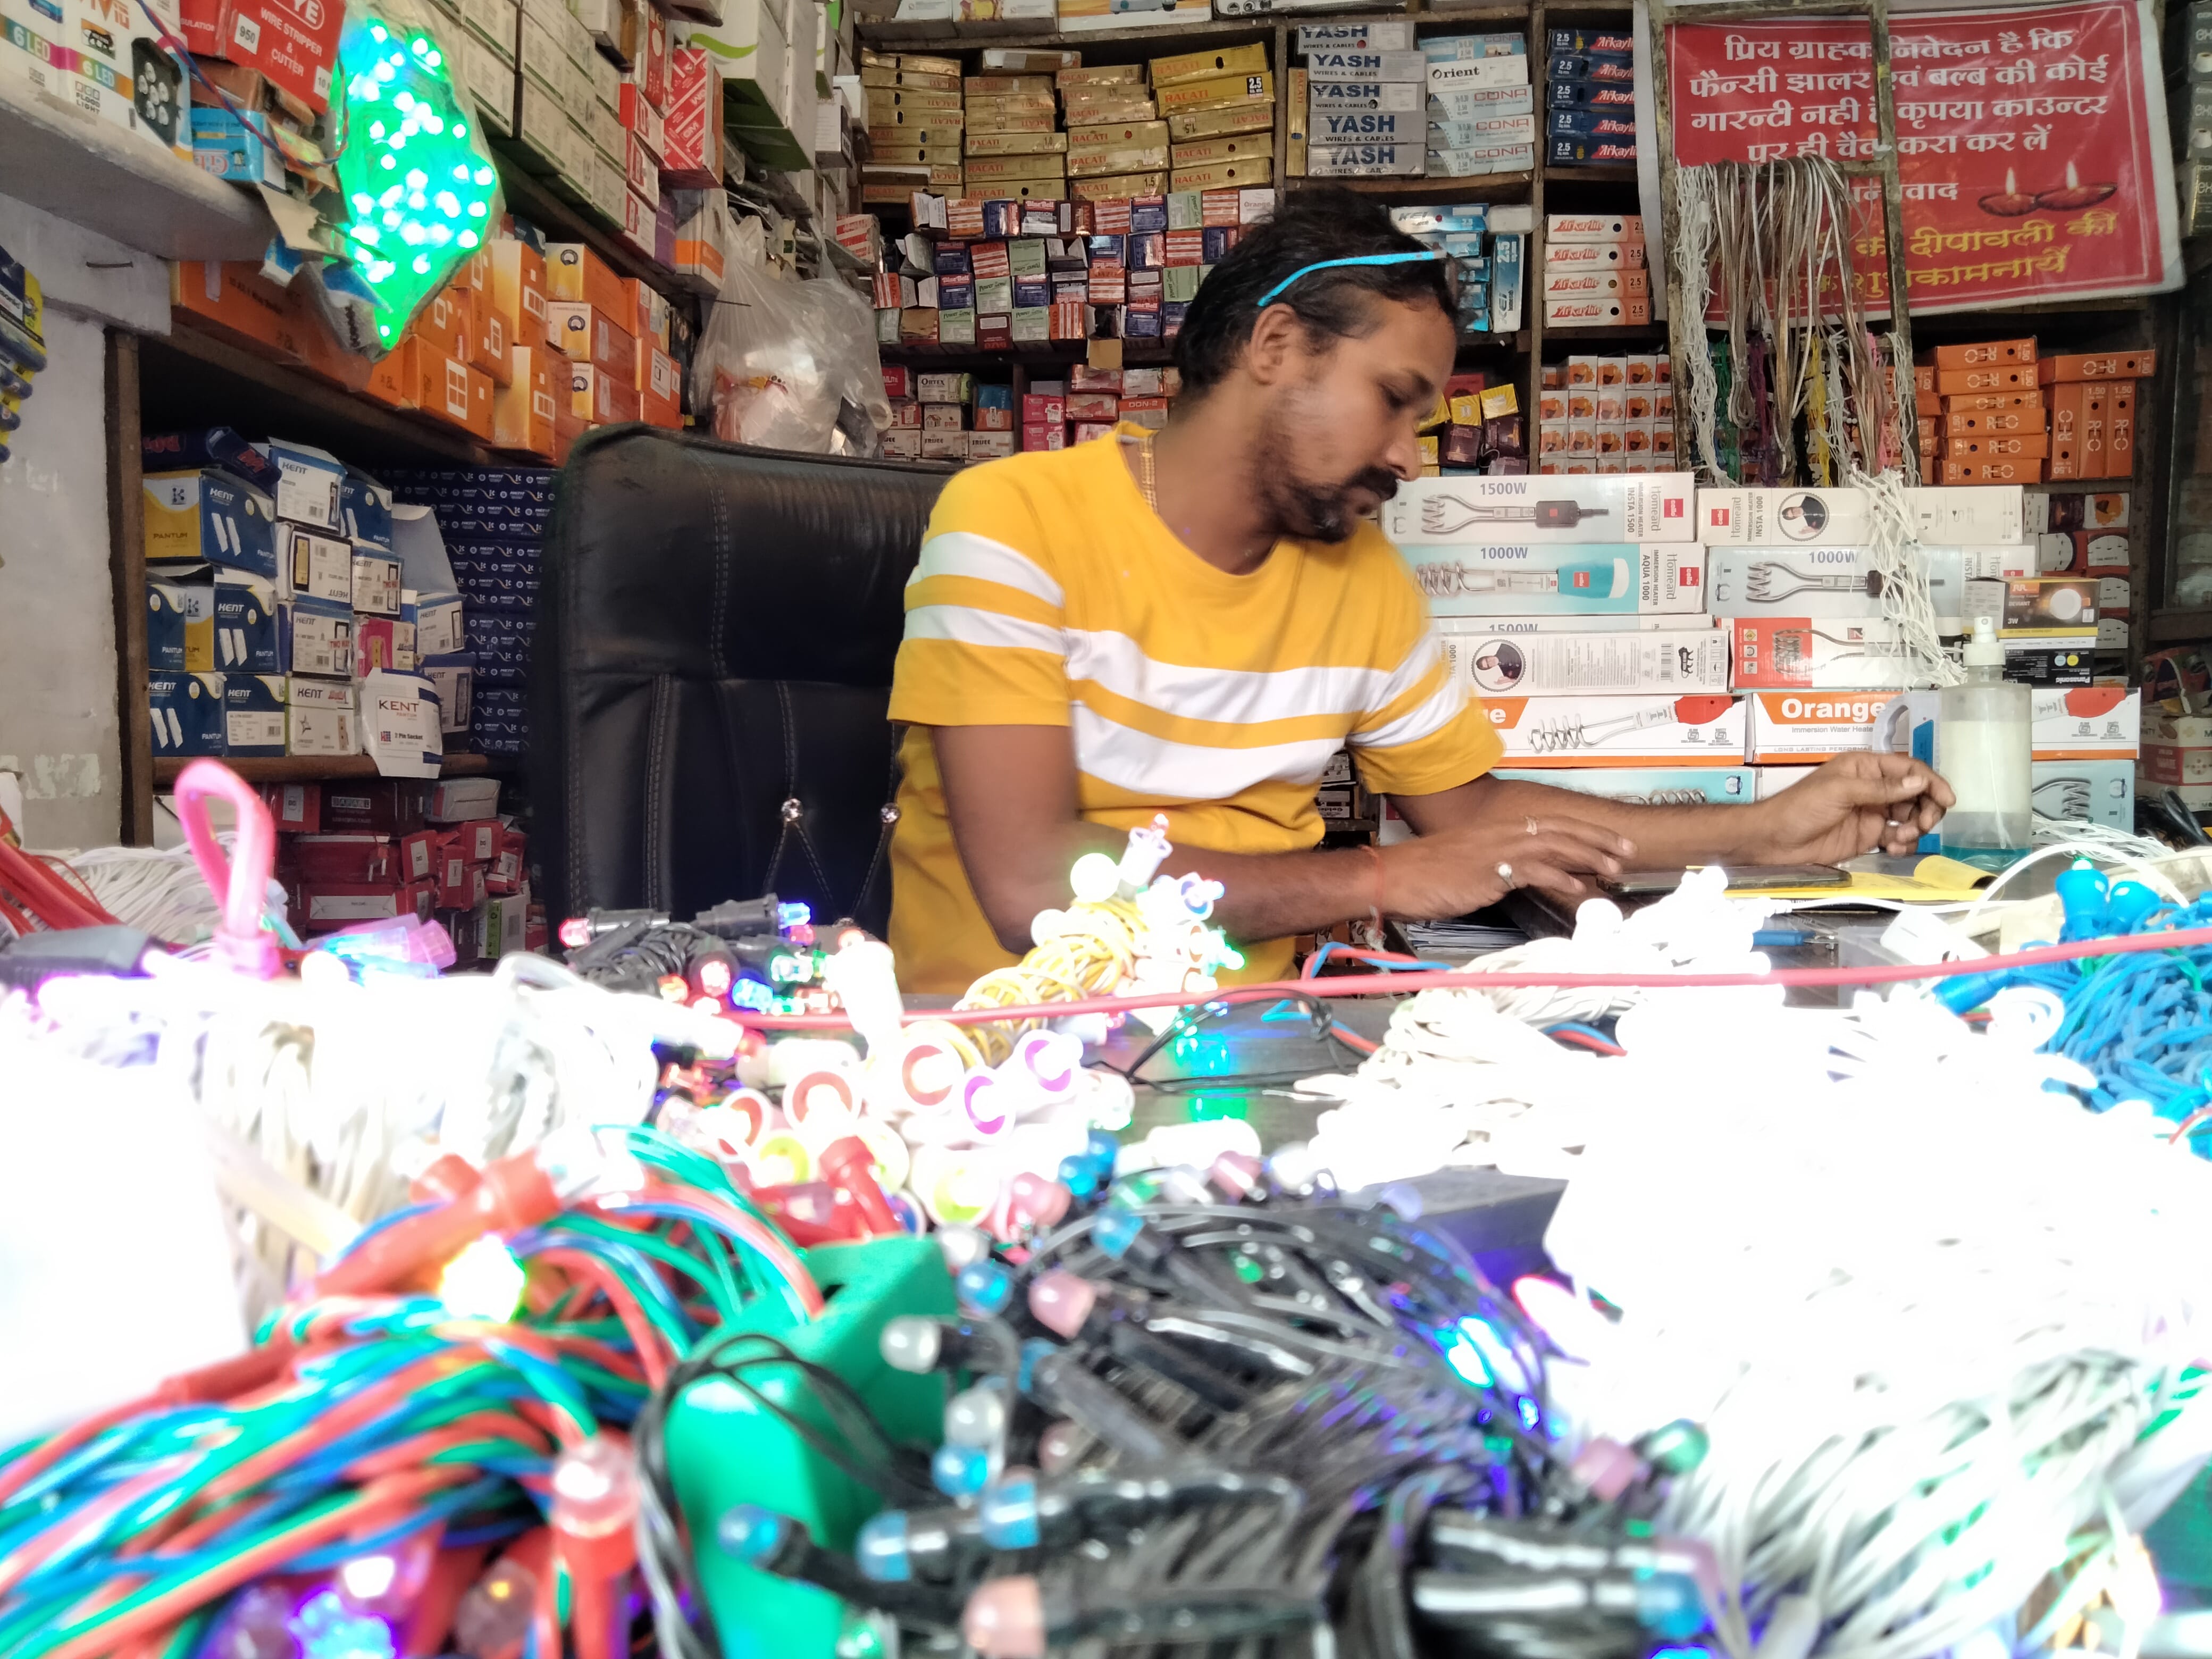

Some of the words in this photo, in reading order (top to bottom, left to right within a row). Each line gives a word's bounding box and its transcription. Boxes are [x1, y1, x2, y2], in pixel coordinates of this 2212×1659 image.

[239, 26, 256, 44] 950
[261, 7, 282, 30] WIRE
[283, 23, 323, 57] STRIPPER
[1301, 26, 1368, 38] YASH
[13, 26, 24, 47] 6
[27, 33, 50, 61] LED
[287, 42, 294, 53] &
[1597, 37, 1634, 49] Arkayli
[1724, 35, 1781, 61] प्रिय
[1889, 35, 1990, 58] निवेदन
[1998, 31, 2024, 53] है
[2028, 28, 2077, 51] कि
[271, 48, 304, 77] CUTTER
[1314, 54, 1381, 69] YASH
[1560, 61, 1572, 70] 2.5
[82, 61, 93, 76] 6
[96, 66, 114, 87] LED
[1432, 66, 1480, 80] Orient
[1601, 64, 1635, 78] Arkayli
[1690, 66, 1778, 98] फैन्सी
[1785, 72, 1871, 94] झालर
[1928, 67, 1988, 86] बल्ब
[1995, 58, 2037, 85] की
[2045, 54, 2109, 83] कोई
[1165, 90, 1209, 103] RACATI
[1313, 85, 1380, 97] YASH
[1474, 88, 1527, 102] CONA
[1557, 86, 1570, 95] 2.5
[76, 92, 100, 108] FLOOD
[76, 99, 100, 115] LIGHT
[1691, 99, 1794, 131] गारन्टी
[1800, 97, 1861, 125] नही
[1896, 101, 1985, 129] कृपया
[1990, 96, 2109, 118] काउन्टर
[1185, 123, 1196, 133] 1.5
[1326, 115, 1395, 133] YASH
[1476, 118, 1529, 131] CONA
[1072, 133, 1108, 143] RACATI
[1747, 142, 1789, 163] पर
[1795, 132, 1829, 159] ही
[1897, 136, 1958, 155] करा
[1965, 132, 2016, 152] कर
[2022, 123, 2054, 150] लें
[1176, 147, 1211, 158] RACATI
[1329, 146, 1395, 165] YASH
[1474, 145, 1528, 158] CONA
[1071, 156, 1107, 166] RACATI
[968, 164, 1004, 172] RACATI
[1144, 177, 1155, 187] 1.5
[1175, 173, 1211, 184] RACATI
[969, 189, 1005, 198] RACATI
[1074, 184, 1108, 193] RACATI
[1554, 219, 1604, 232] Arkaylite
[1909, 219, 2056, 258] दीपावली
[2065, 209, 2119, 237] की
[1549, 248, 1601, 262] Arkaylite
[1631, 249, 1641, 258] 2.5
[979, 283, 994, 293] Power
[1549, 276, 1600, 291] Arkaylite
[1630, 278, 1641, 287] 2.5
[1551, 304, 1603, 318] Arkaylite
[1632, 305, 1644, 314] 2.5
[282, 462, 308, 475] KENT
[210, 488, 234, 501] KENT
[339, 485, 355, 495] ENT
[1480, 482, 1527, 496] 1500W
[1480, 547, 1528, 559] 1000W
[1809, 550, 1858, 564] 1000W
[1642, 555, 1650, 577] AQUA
[1685, 568, 1694, 586] cello
[328, 589, 348, 598] KENT
[1641, 581, 1650, 601] 1000
[218, 604, 244, 612] KENT
[296, 617, 315, 625] KENT
[1448, 644, 1457, 663] 1000
[149, 682, 177, 690] KENT
[297, 688, 323, 699] KENT
[379, 700, 419, 712] KENT
[1781, 698, 1887, 722] Orange
